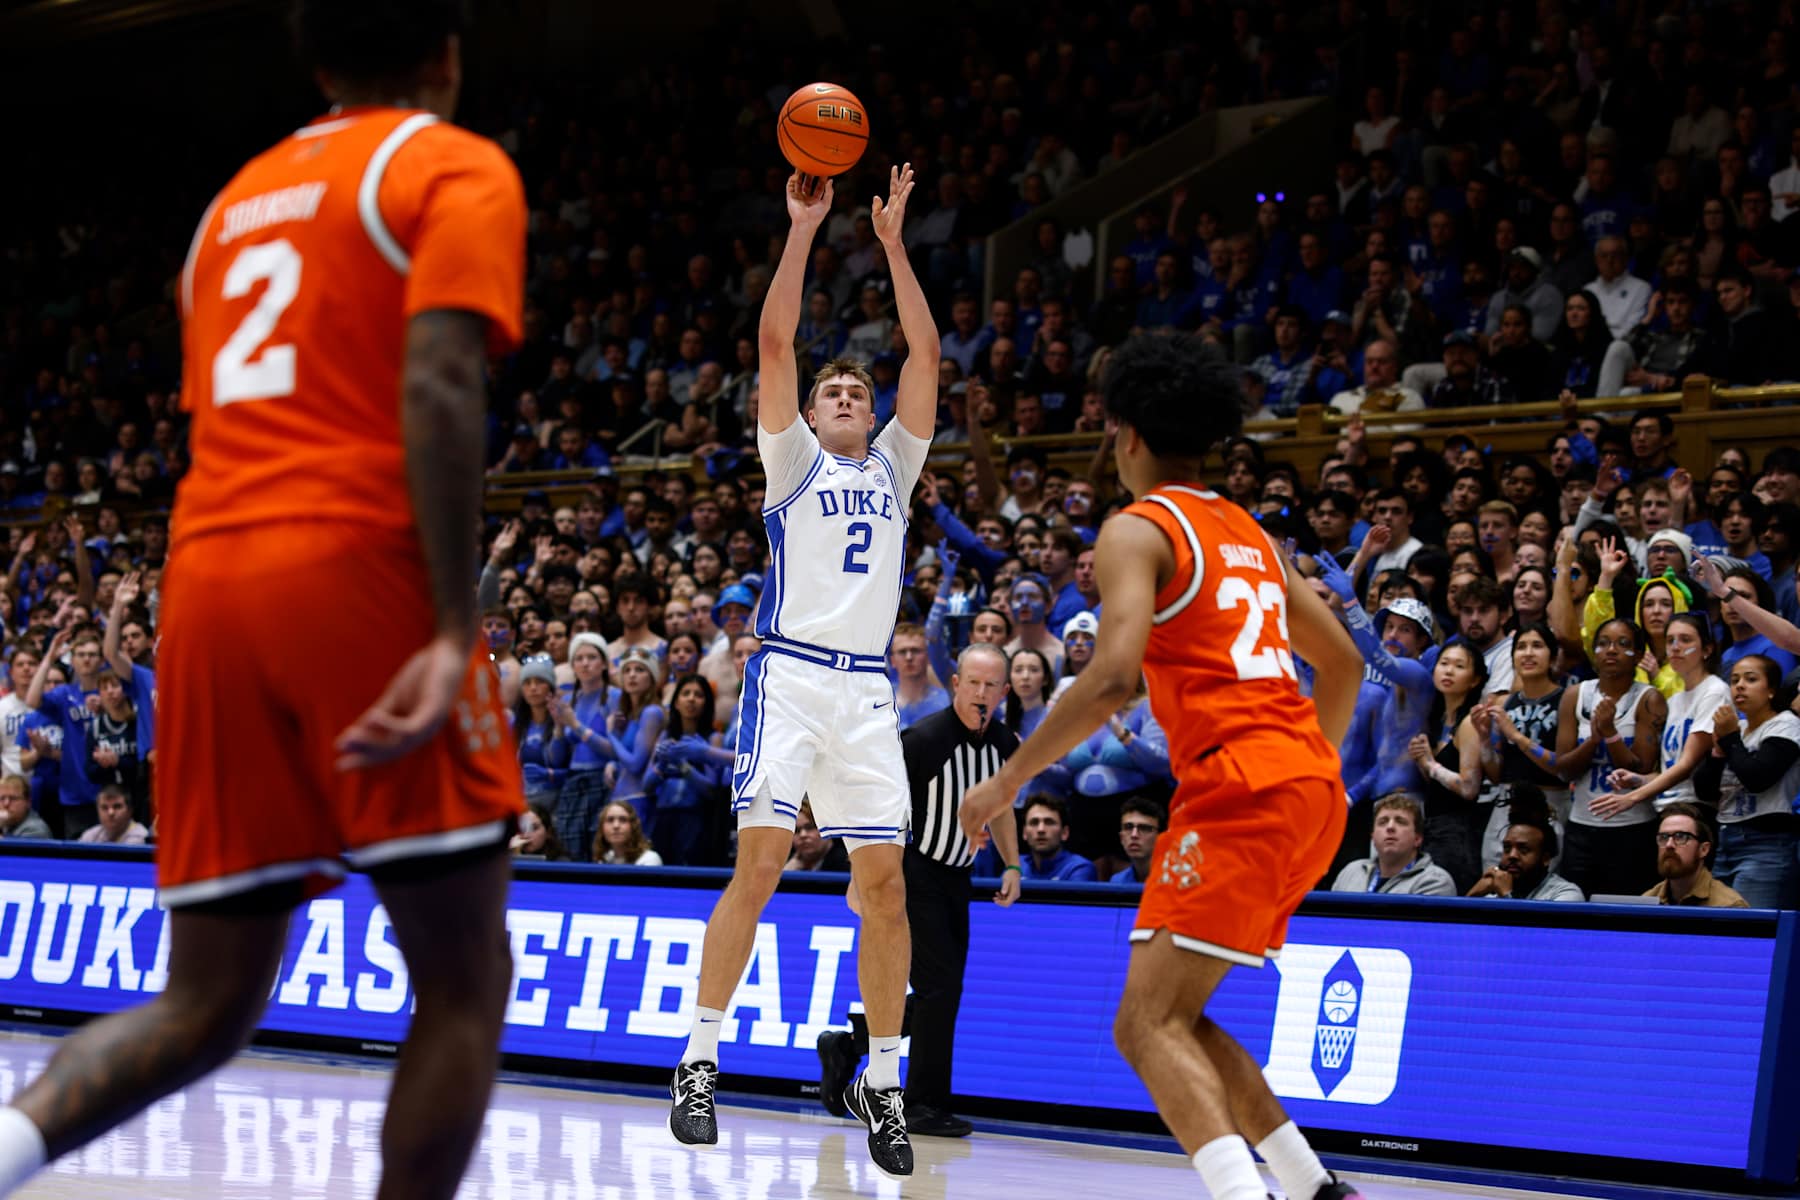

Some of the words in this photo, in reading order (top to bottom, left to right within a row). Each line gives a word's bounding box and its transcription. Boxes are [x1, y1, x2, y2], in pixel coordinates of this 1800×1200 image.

[213, 238, 303, 407] 2
[817, 489, 893, 521] DUKE
[843, 522, 873, 574] 2
[1216, 577, 1298, 681] 23
[0, 880, 171, 992] DUK
[268, 899, 911, 1058] ASETBAL
[1361, 1139, 1419, 1152] DAKTRONICS
